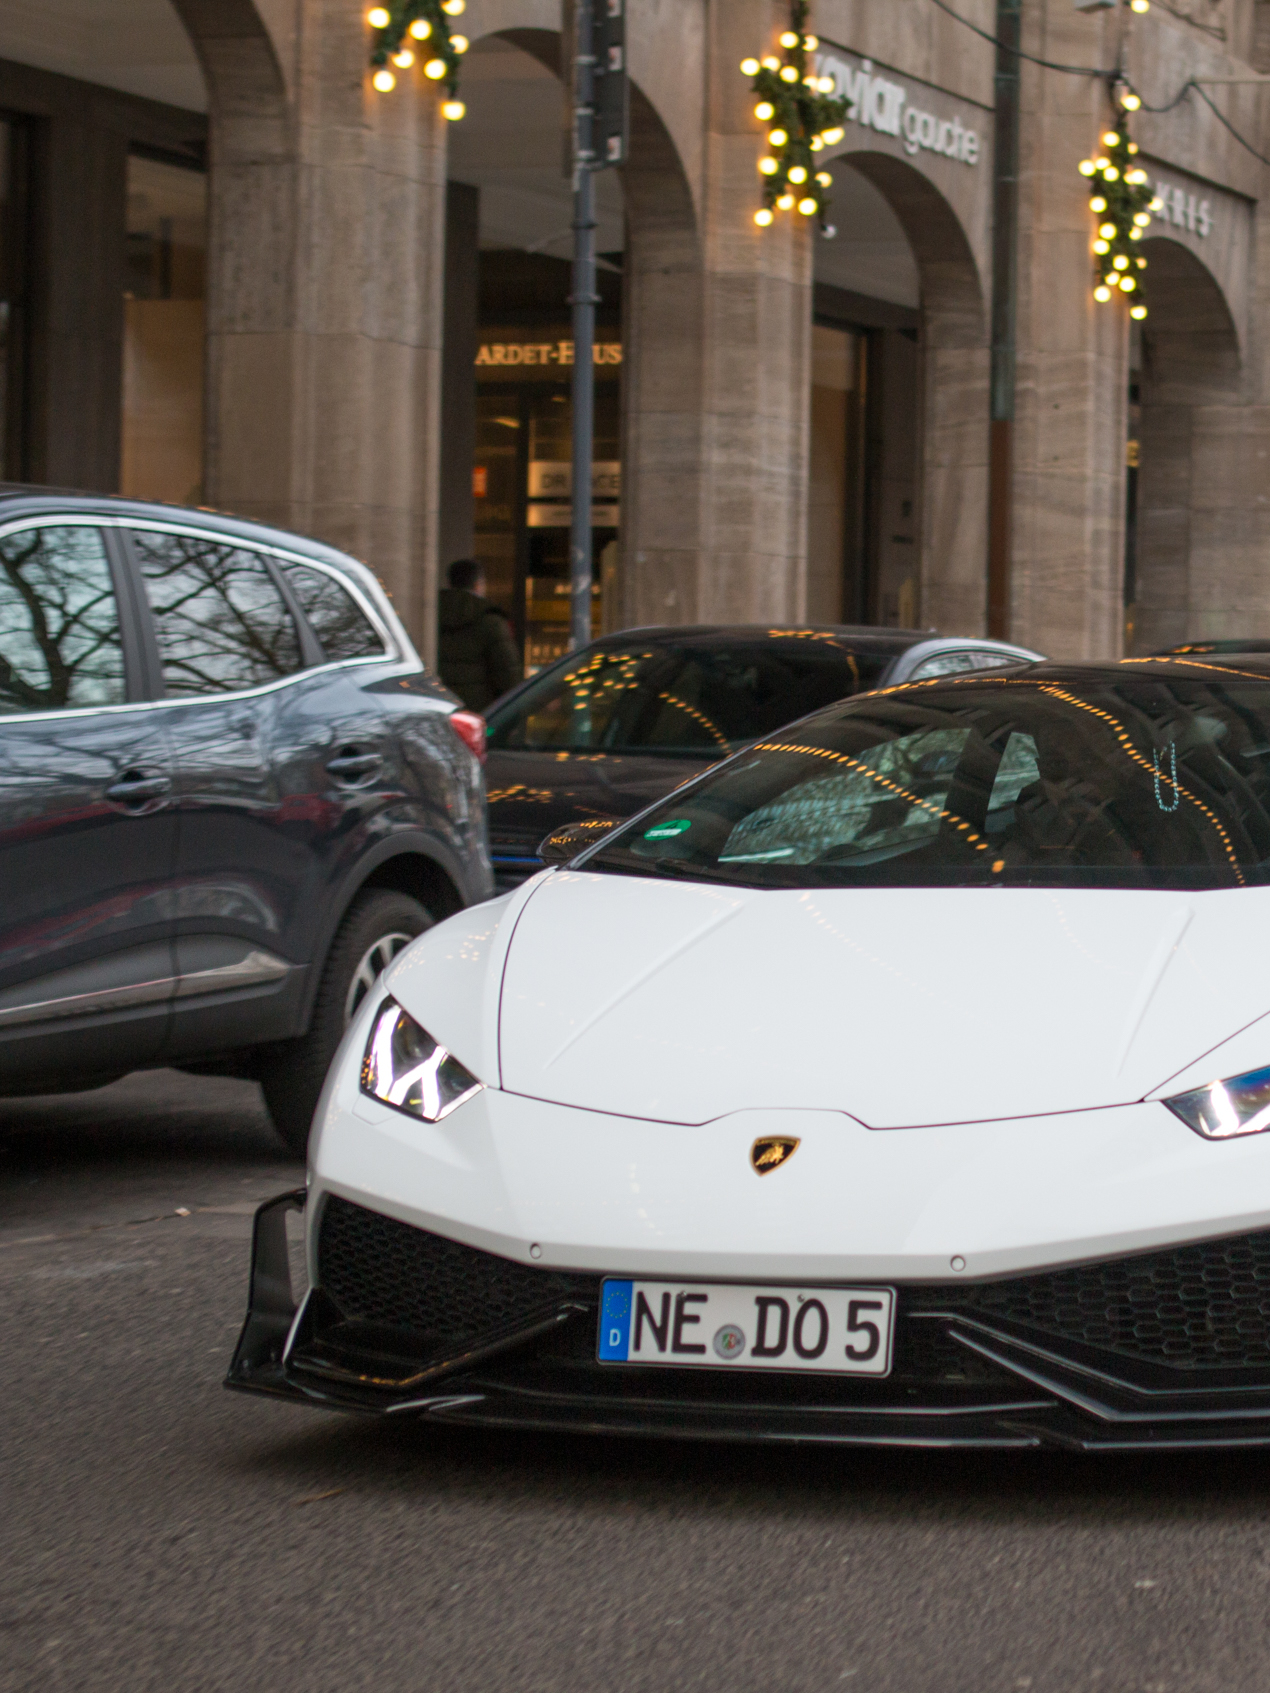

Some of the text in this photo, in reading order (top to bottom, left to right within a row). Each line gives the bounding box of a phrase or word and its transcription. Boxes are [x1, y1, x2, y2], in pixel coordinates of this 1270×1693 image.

[815, 54, 907, 137] aviar
[609, 1328, 621, 1347] D
[633, 1291, 883, 1361] NE DO 5
